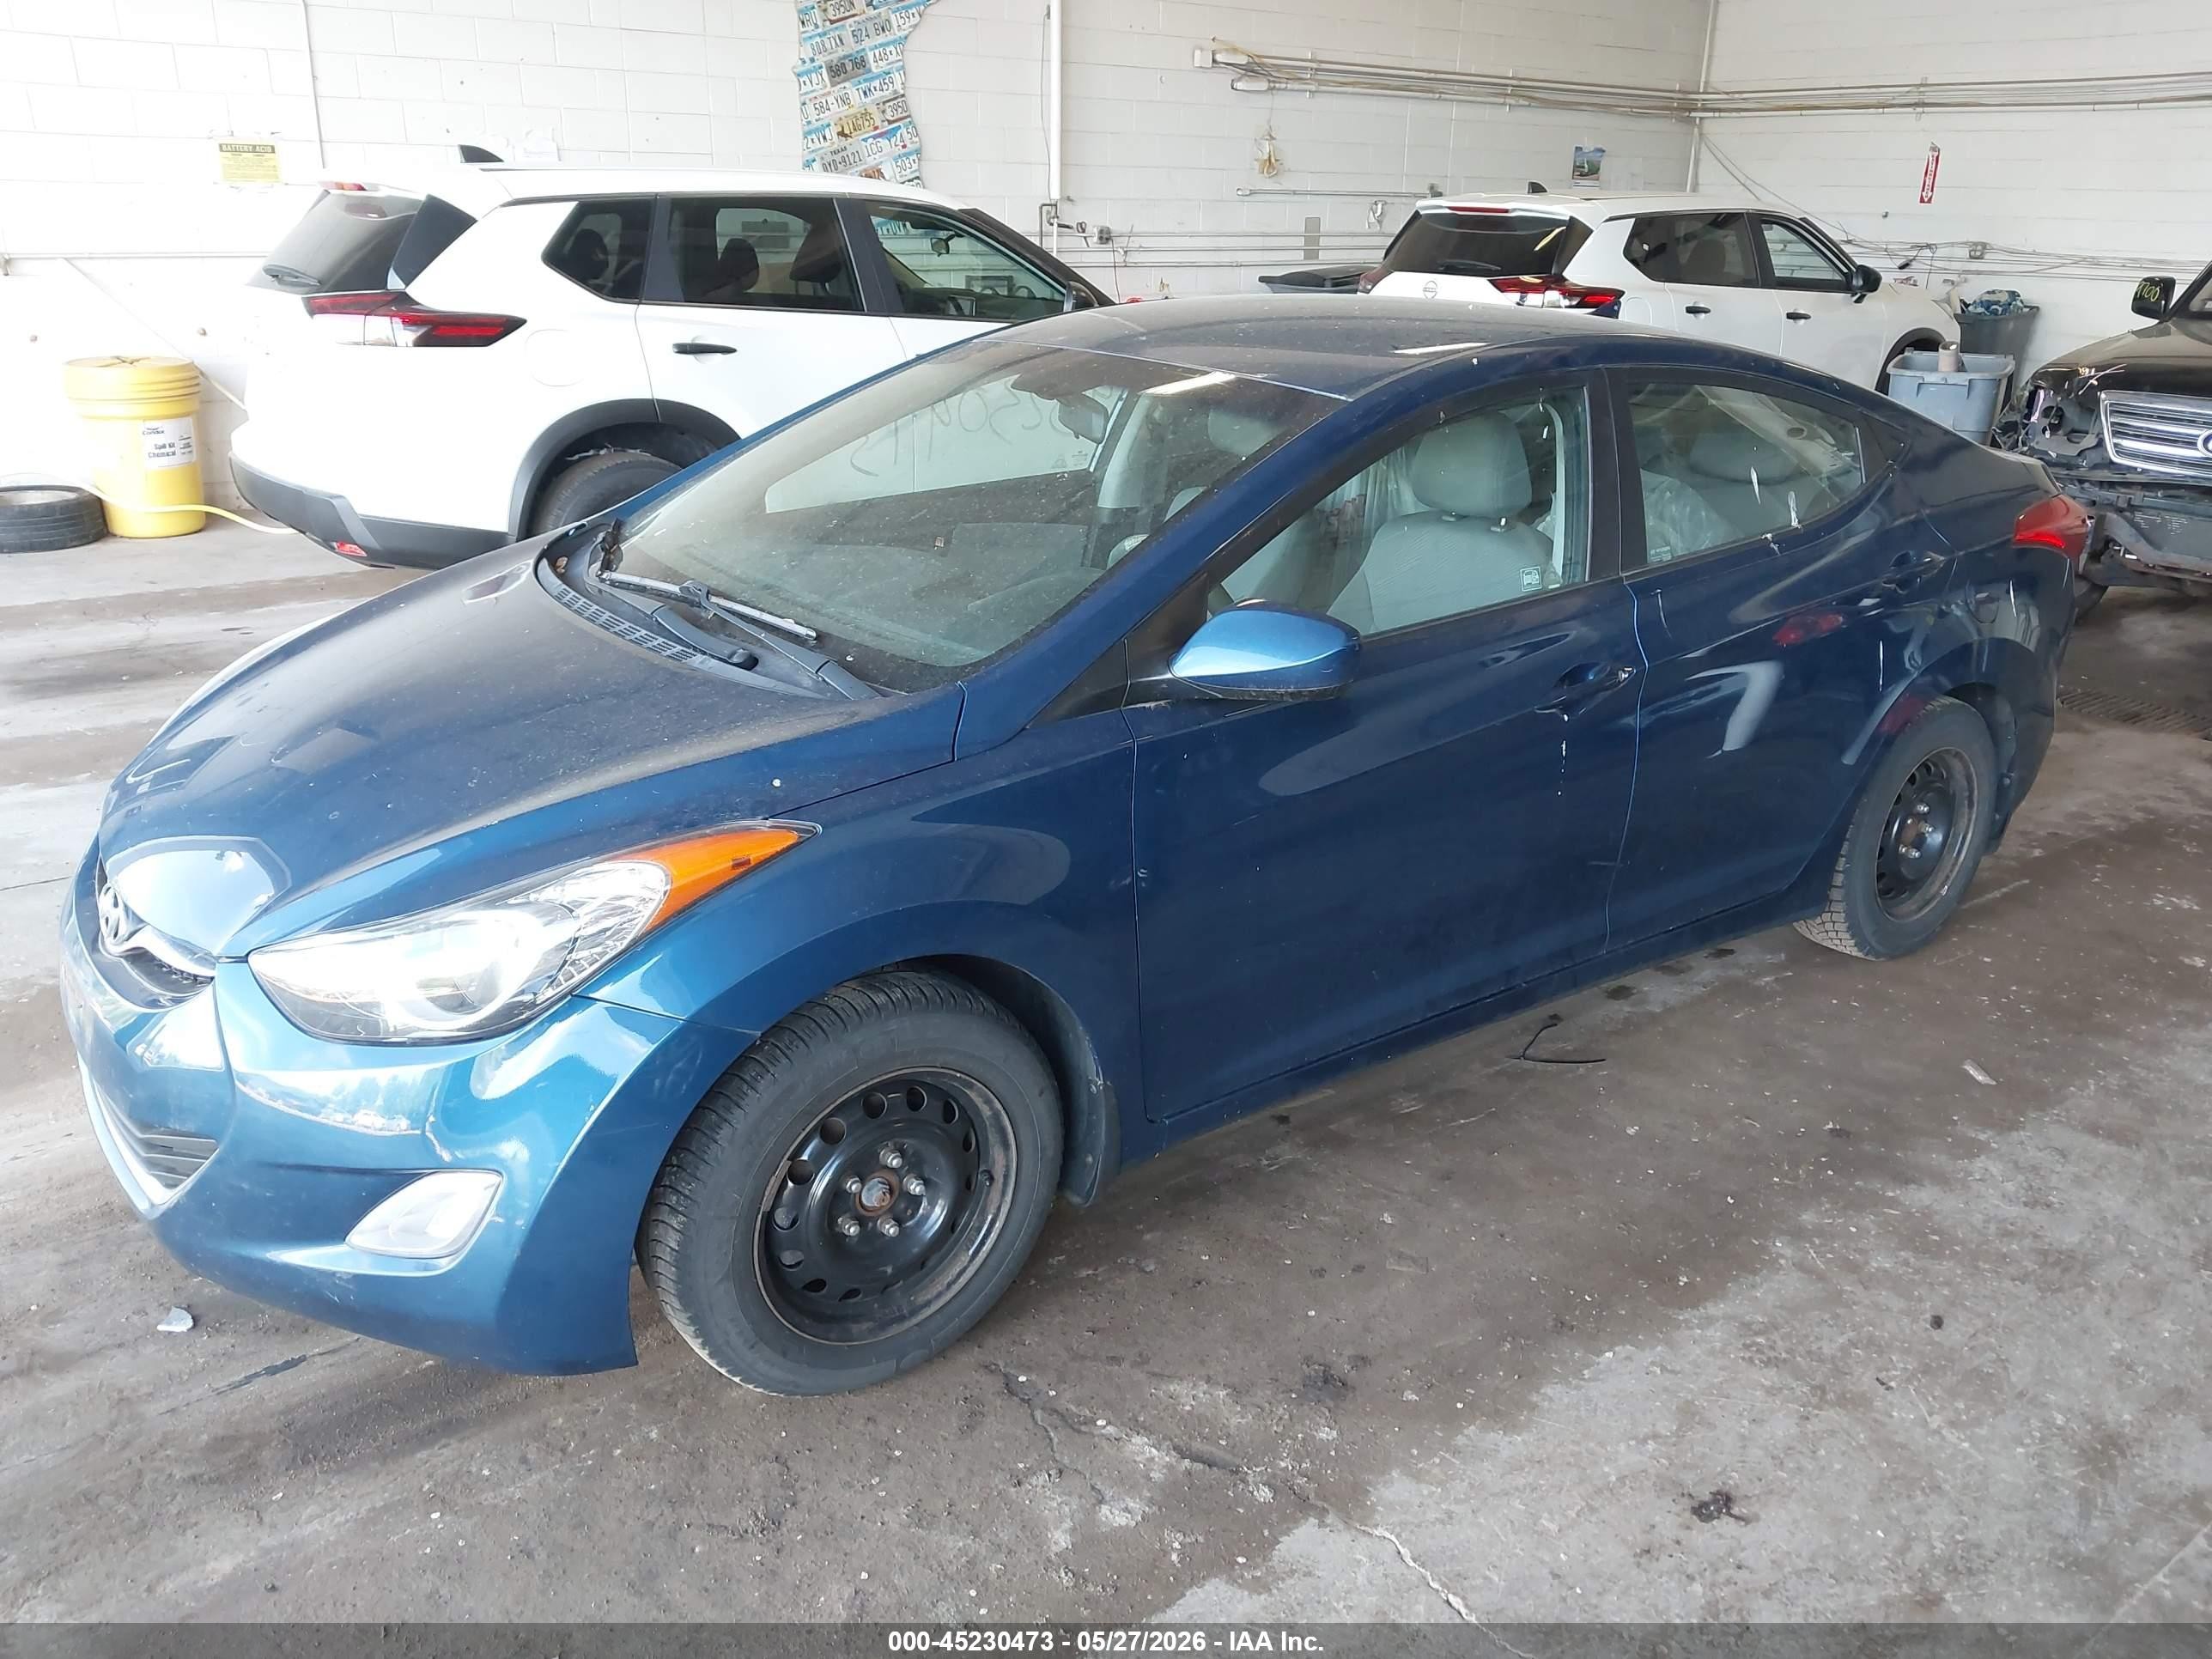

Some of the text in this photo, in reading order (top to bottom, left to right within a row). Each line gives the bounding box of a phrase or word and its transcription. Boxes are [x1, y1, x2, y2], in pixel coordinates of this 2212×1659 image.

[852, 27, 871, 44] 524
[830, 55, 866, 79] 580 768
